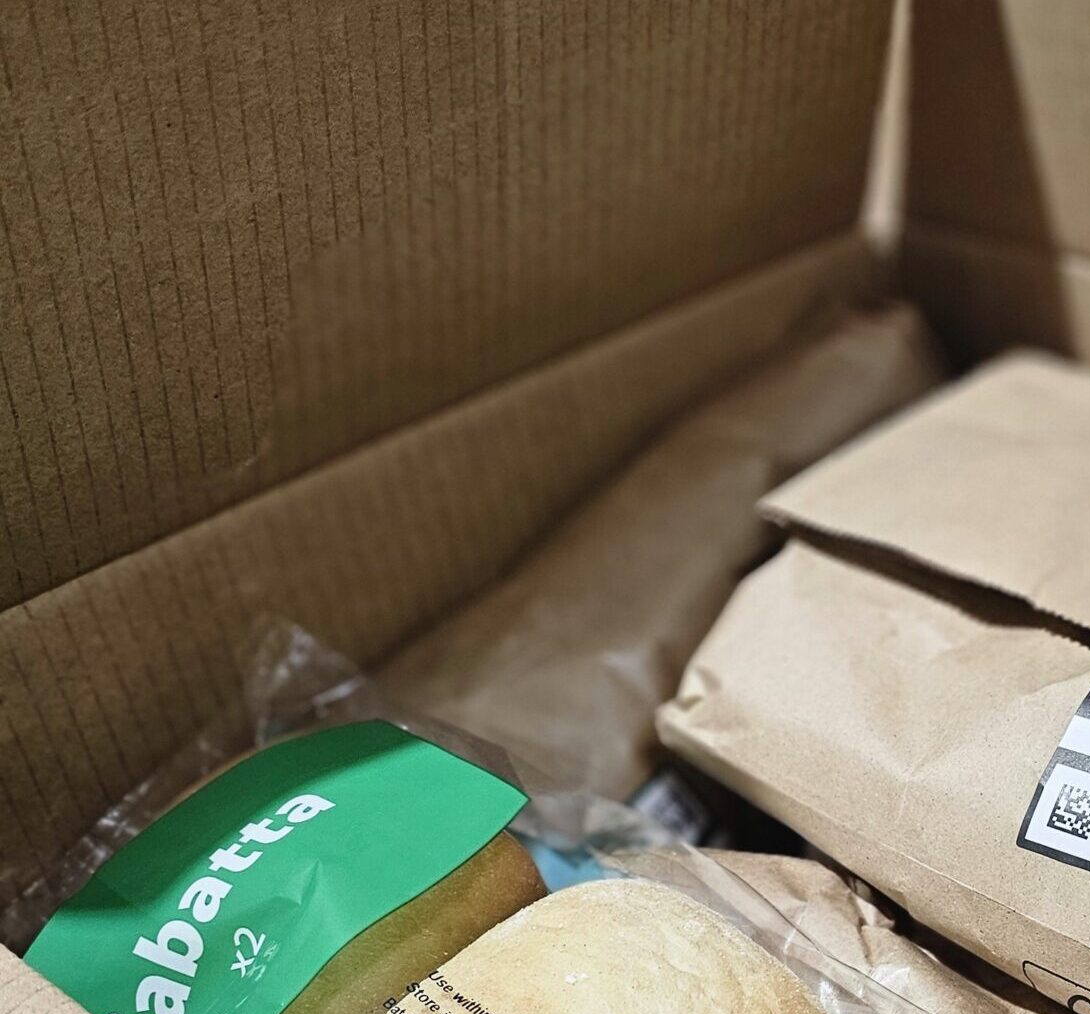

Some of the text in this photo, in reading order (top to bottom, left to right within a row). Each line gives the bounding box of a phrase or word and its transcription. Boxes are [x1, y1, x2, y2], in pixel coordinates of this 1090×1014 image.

[230, 927, 266, 978] x2
[428, 970, 454, 993] Use
[406, 982, 440, 1012] Store
